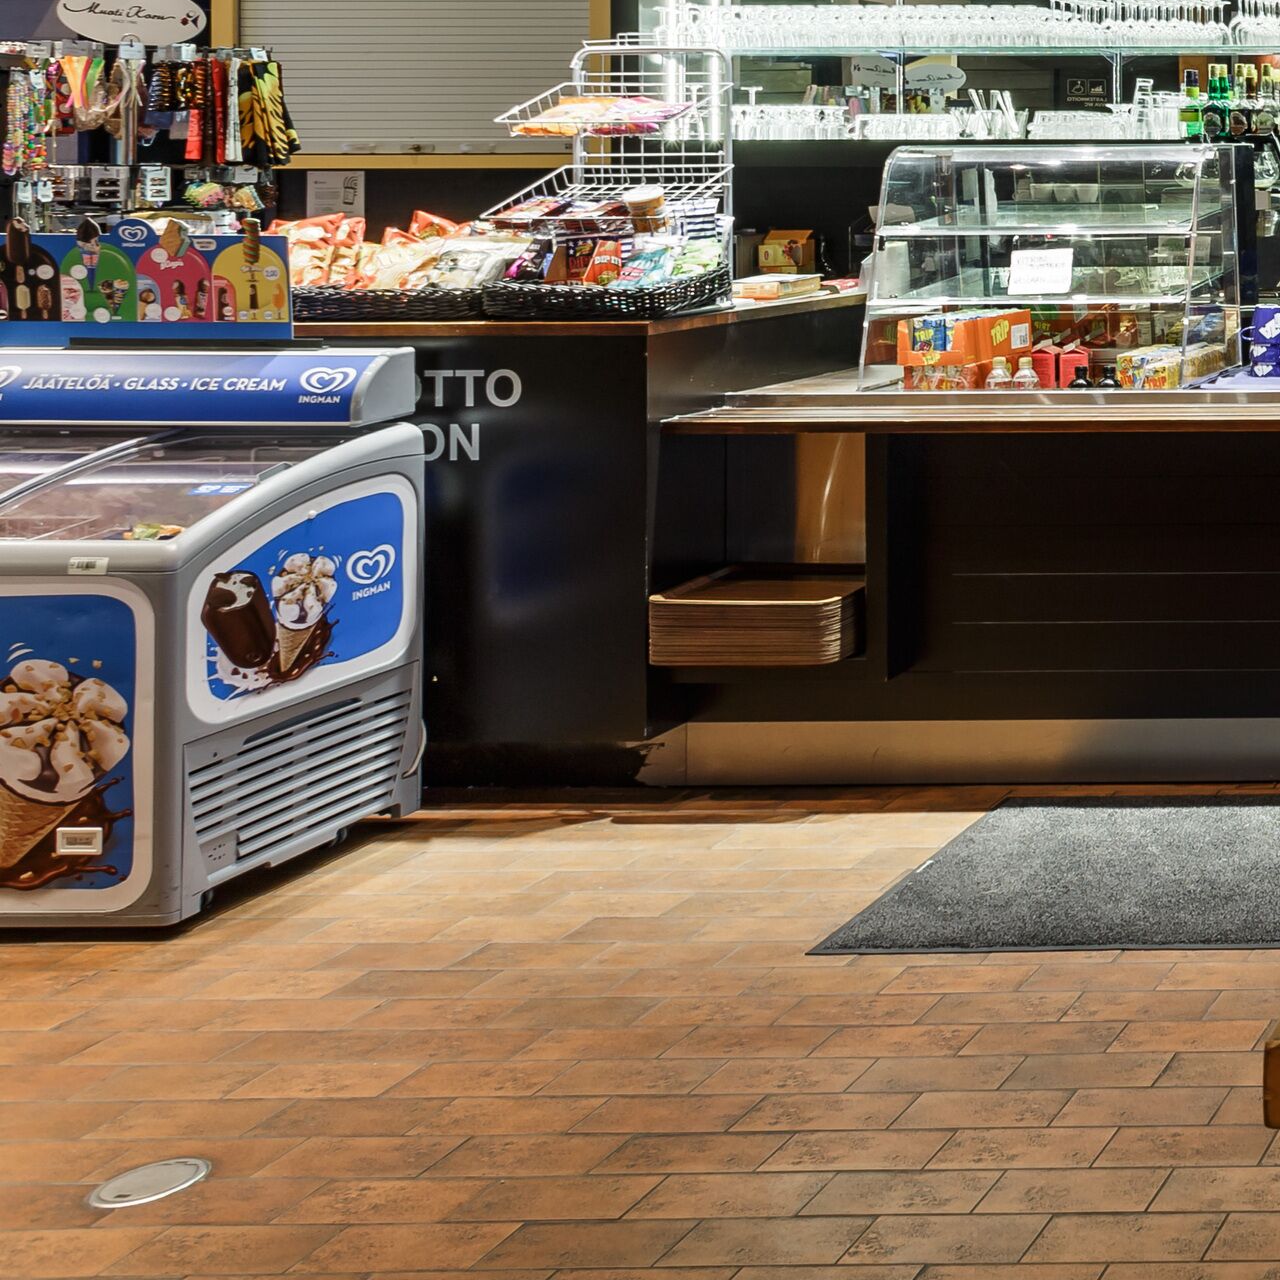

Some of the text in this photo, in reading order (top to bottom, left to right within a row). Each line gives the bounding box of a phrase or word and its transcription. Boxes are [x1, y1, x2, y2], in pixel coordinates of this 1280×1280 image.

[991, 319, 1009, 346] TRIP
[123, 377, 178, 391] GLASS
[189, 378, 218, 391] ICE
[223, 378, 287, 391] CREAM
[415, 369, 522, 408] TTO
[297, 394, 341, 404] INGMAN
[352, 581, 391, 601] INGMAN
